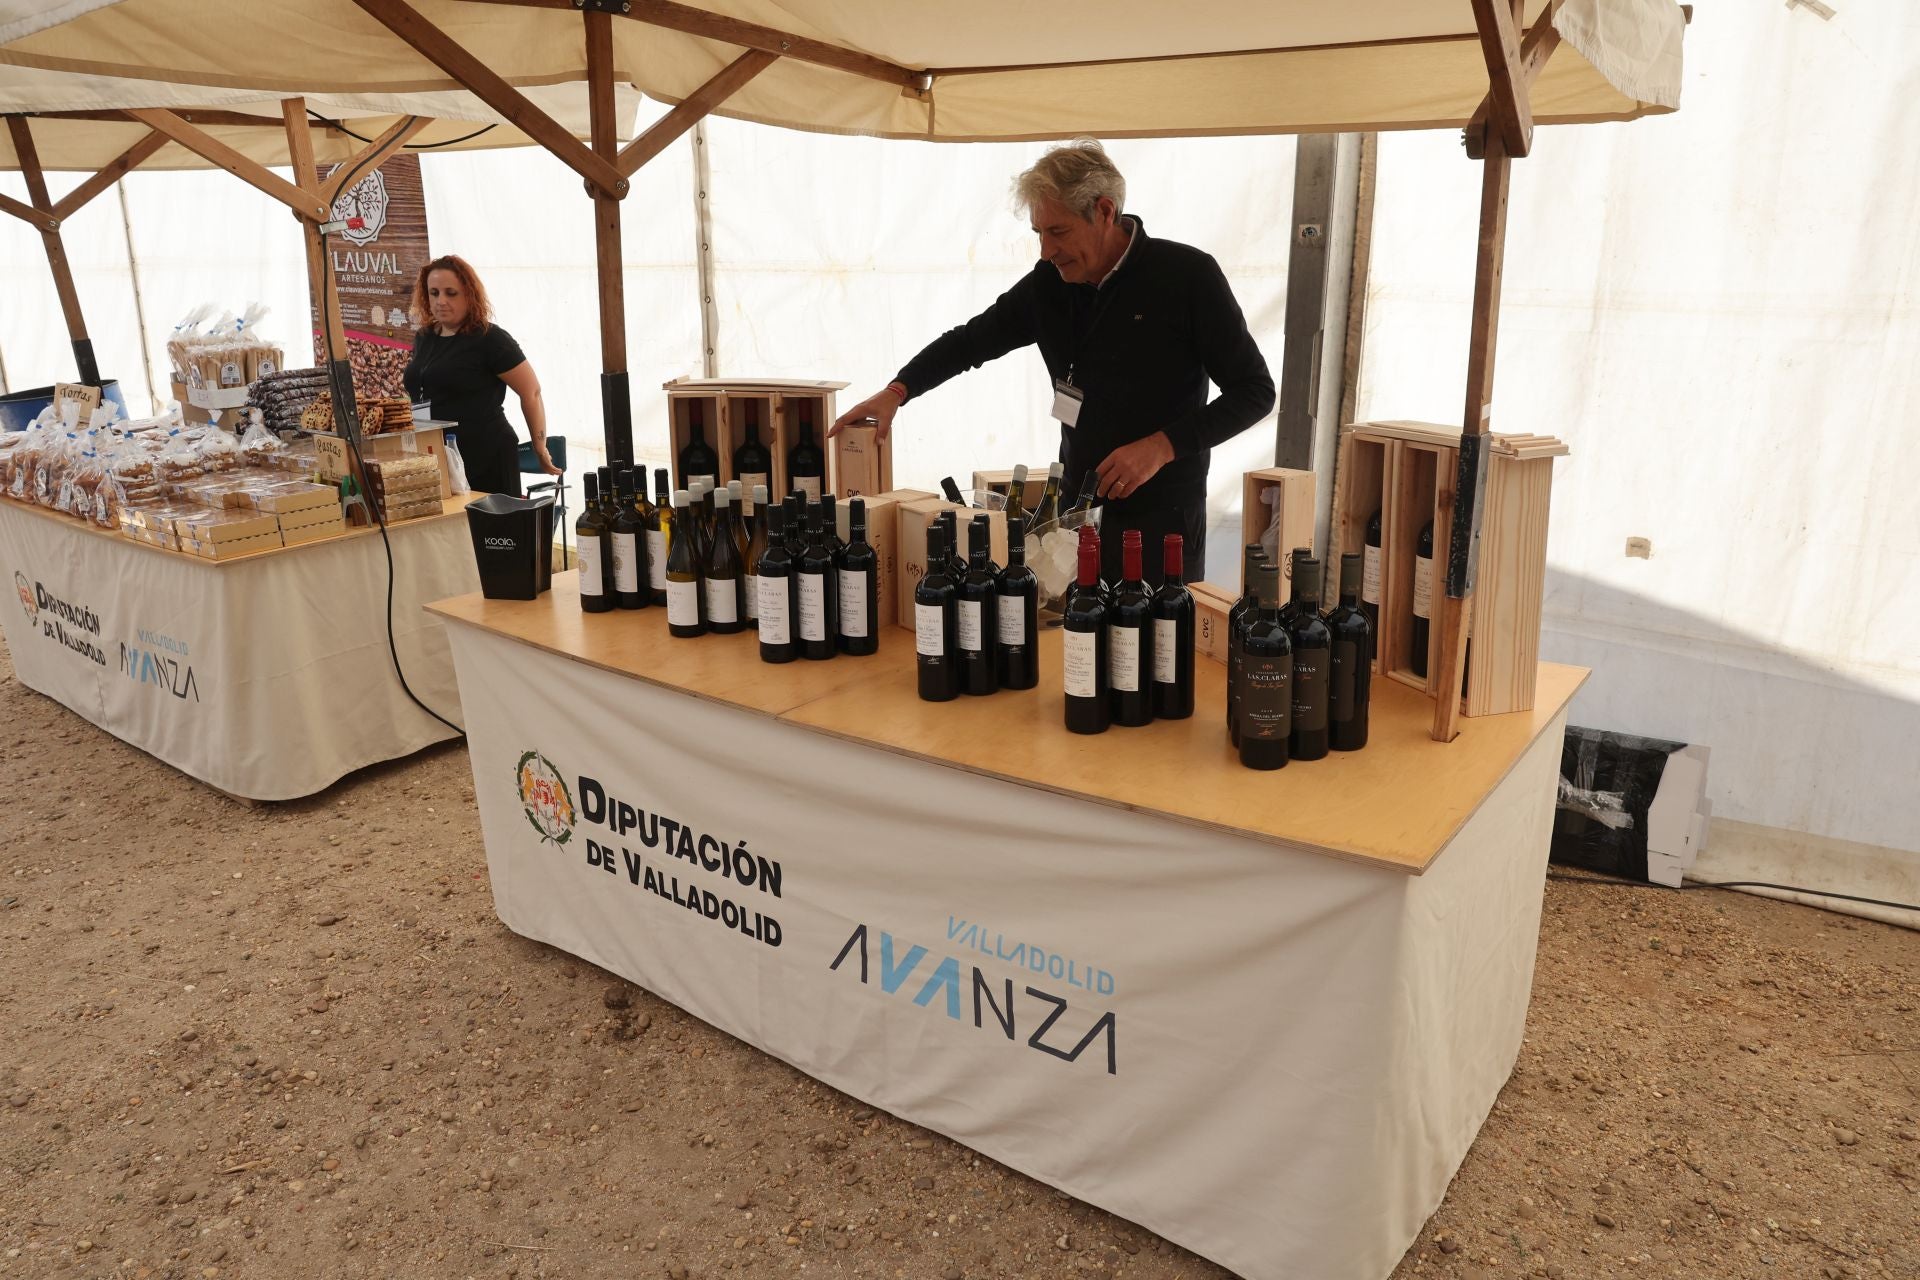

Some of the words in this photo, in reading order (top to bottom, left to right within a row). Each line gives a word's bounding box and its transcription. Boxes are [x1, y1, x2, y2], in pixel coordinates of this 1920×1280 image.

[331, 252, 402, 275] LAUVAL
[341, 274, 386, 284] ARTESANOS
[60, 386, 92, 402] Tortas
[316, 438, 341, 458] Pastas
[137, 628, 189, 656] VALLADOLID
[120, 641, 200, 703] AVANZA
[946, 915, 1116, 996] VALLADOLID
[829, 923, 1117, 1076] AVANZA
